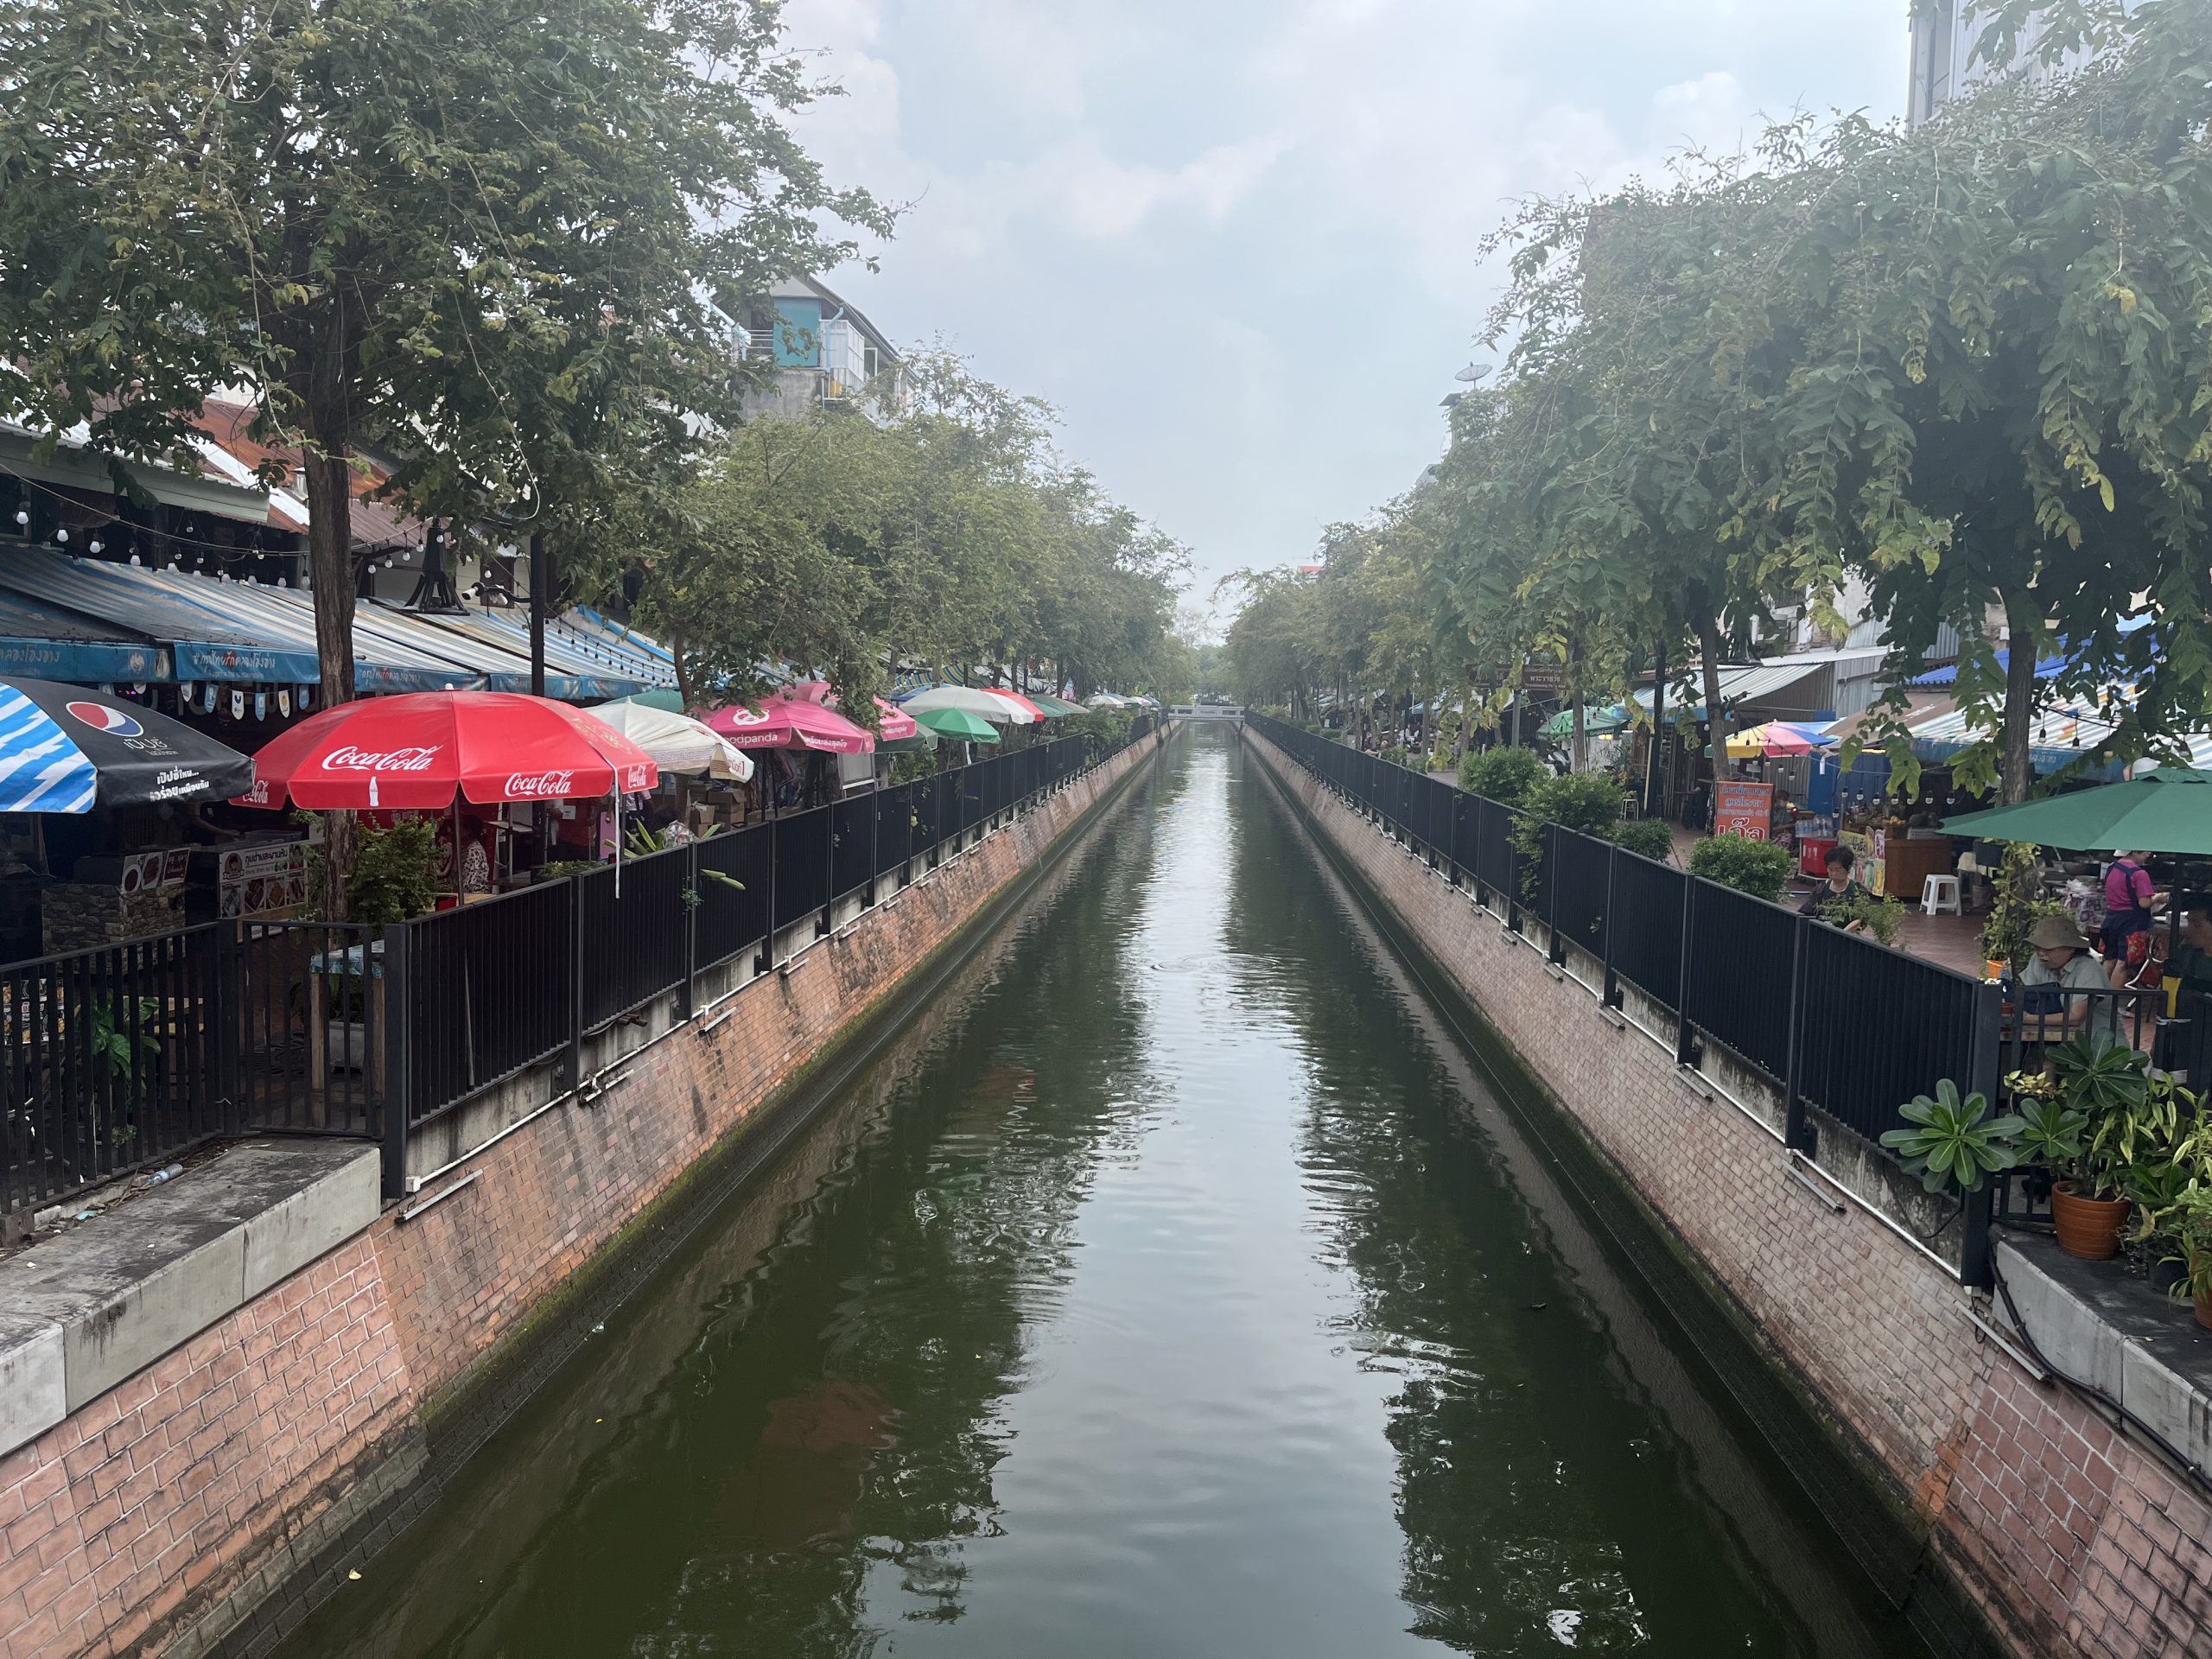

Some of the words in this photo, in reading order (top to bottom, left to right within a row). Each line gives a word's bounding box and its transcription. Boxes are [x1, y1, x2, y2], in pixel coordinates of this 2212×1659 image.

[725, 733, 778, 746] odpanda
[321, 745, 444, 771] Coca-Cola
[505, 771, 574, 797] Coca-Cola
